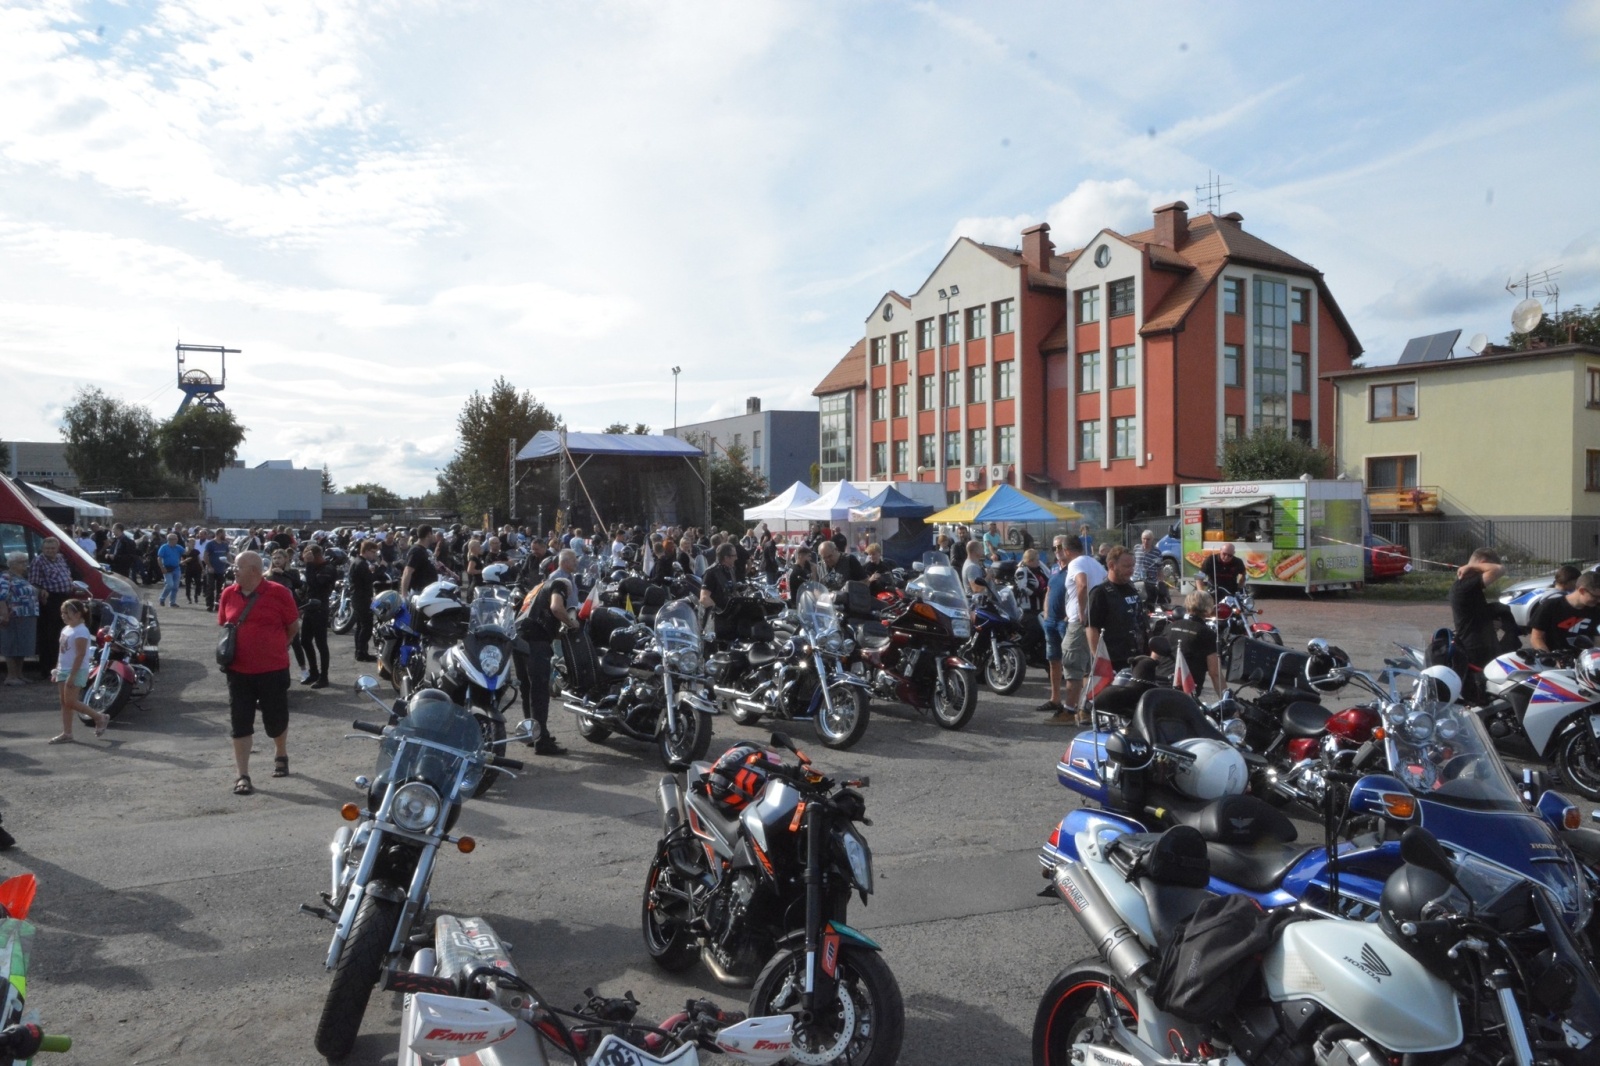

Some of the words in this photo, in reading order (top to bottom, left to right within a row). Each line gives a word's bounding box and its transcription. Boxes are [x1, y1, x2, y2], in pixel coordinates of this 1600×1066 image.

[1210, 485, 1234, 494] BUFET
[1234, 484, 1259, 493] BOBO
[1557, 616, 1592, 633] 4F
[1061, 878, 1088, 910] GIANNELLI
[1343, 955, 1381, 984] HONDA
[424, 1028, 489, 1041] FANTIC
